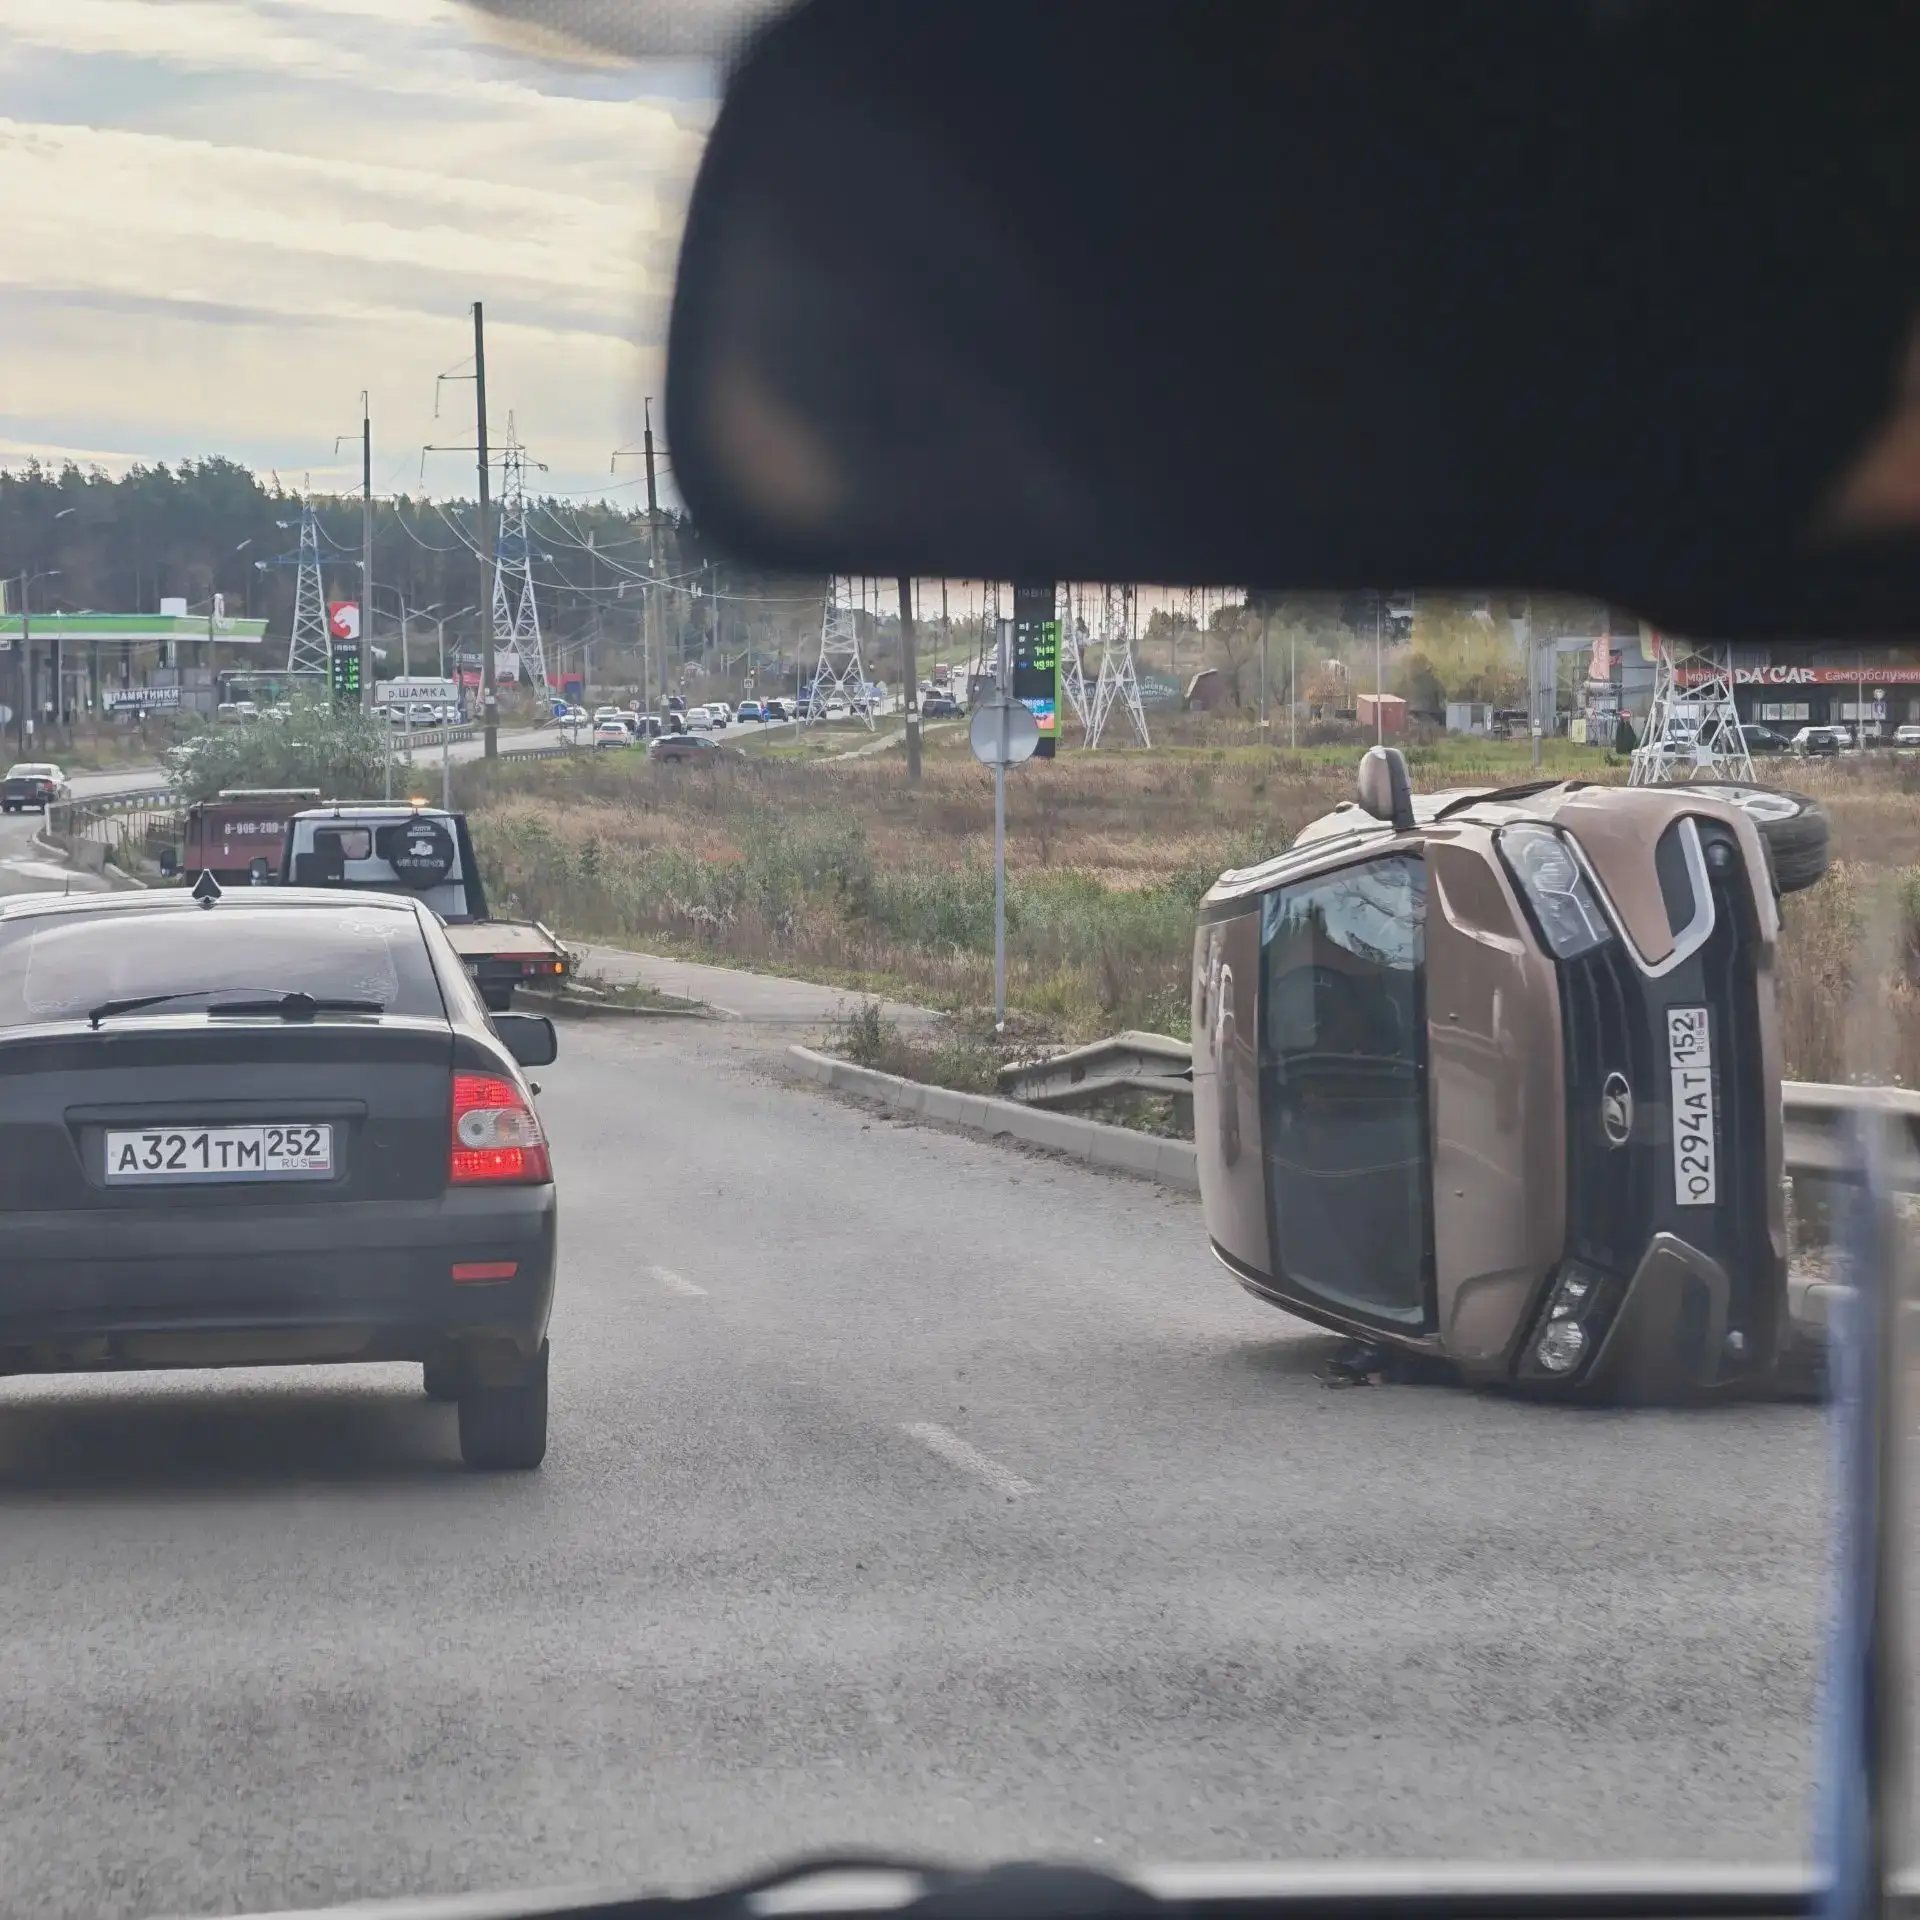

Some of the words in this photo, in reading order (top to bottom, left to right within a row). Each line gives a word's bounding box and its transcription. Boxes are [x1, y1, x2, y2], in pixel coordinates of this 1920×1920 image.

[1825, 667, 1920, 684] самообслужи
[112, 688, 179, 703] ПАМЯТНИКИ
[1671, 1017, 1697, 1063] 152
[267, 1129, 321, 1157] 252
[281, 1158, 309, 1169] RUS
